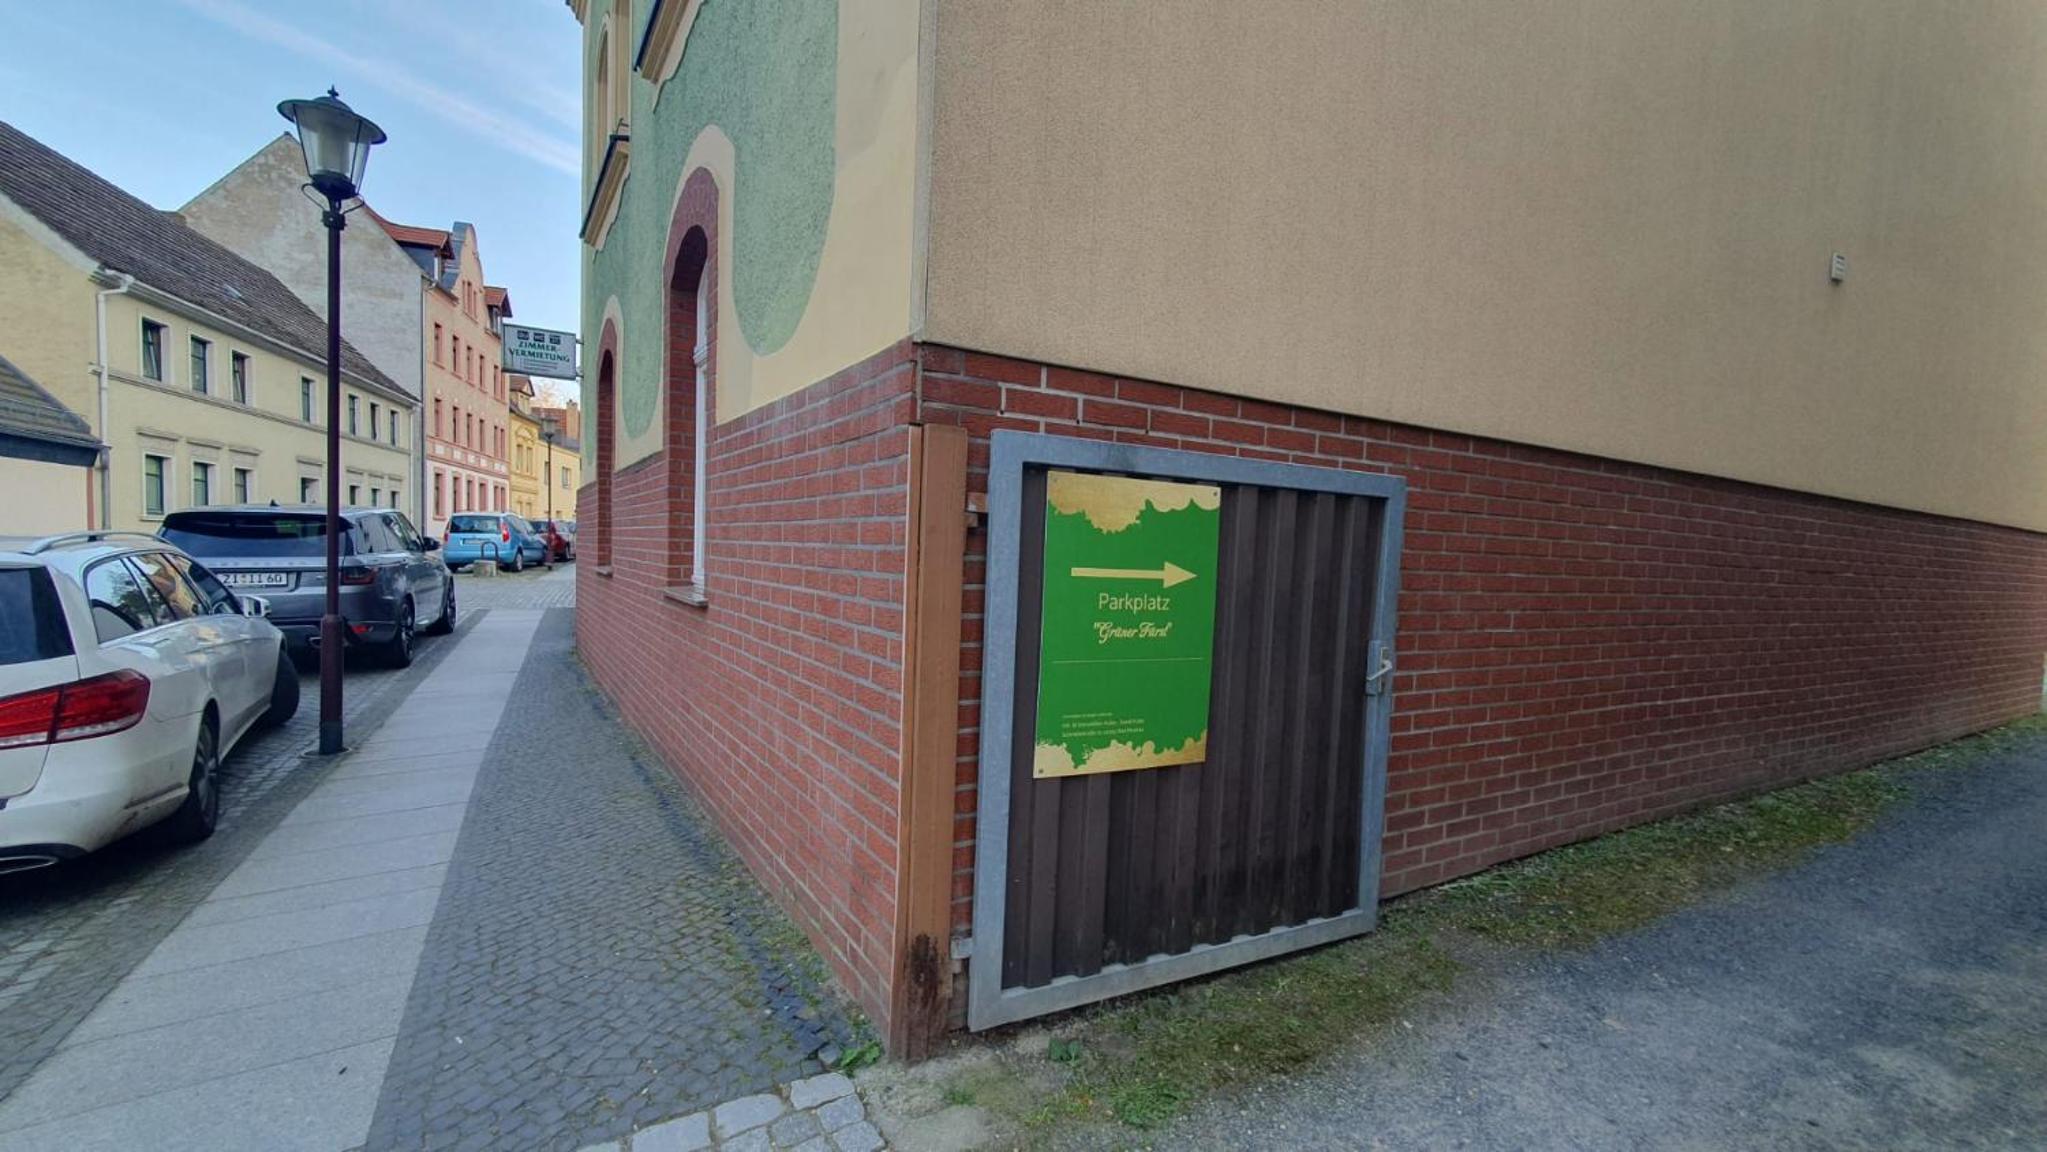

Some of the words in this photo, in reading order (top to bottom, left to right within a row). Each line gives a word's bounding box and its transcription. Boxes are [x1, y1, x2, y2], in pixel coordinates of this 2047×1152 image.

[518, 341, 557, 352] ZIMMER
[509, 348, 570, 362] VERMIETUNG
[1098, 592, 1170, 614] Parkplatz
